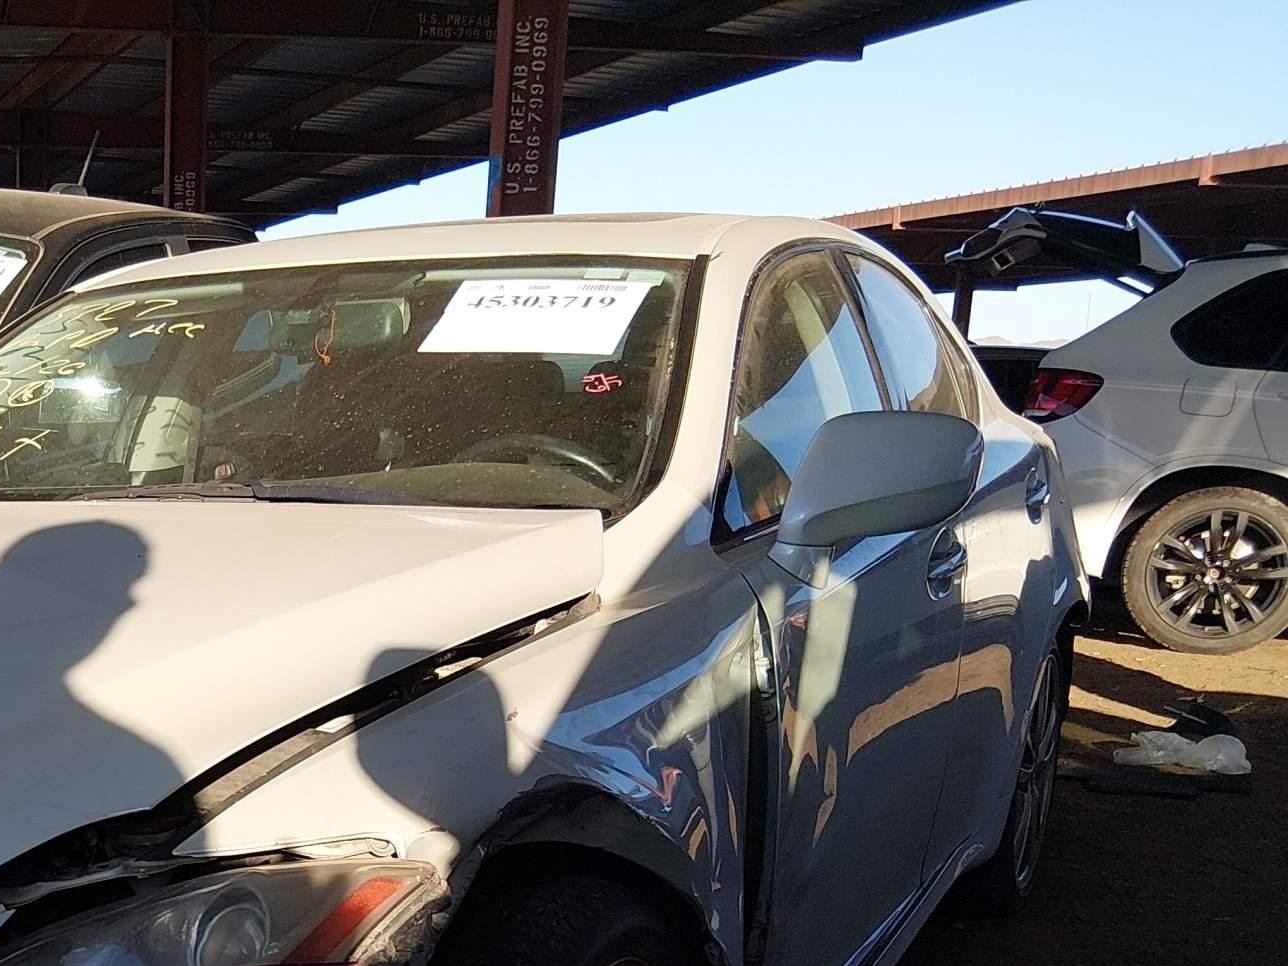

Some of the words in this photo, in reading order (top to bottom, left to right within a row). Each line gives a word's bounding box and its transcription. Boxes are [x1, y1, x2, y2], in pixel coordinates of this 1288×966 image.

[418, 12, 440, 25] U.S.
[447, 14, 490, 28] PREFAB
[514, 15, 533, 54] INC.
[509, 64, 529, 144] PREFAB
[522, 17, 550, 193] 1-866-799-0969
[504, 157, 524, 195] U.S.
[468, 295, 618, 310] 45303719
